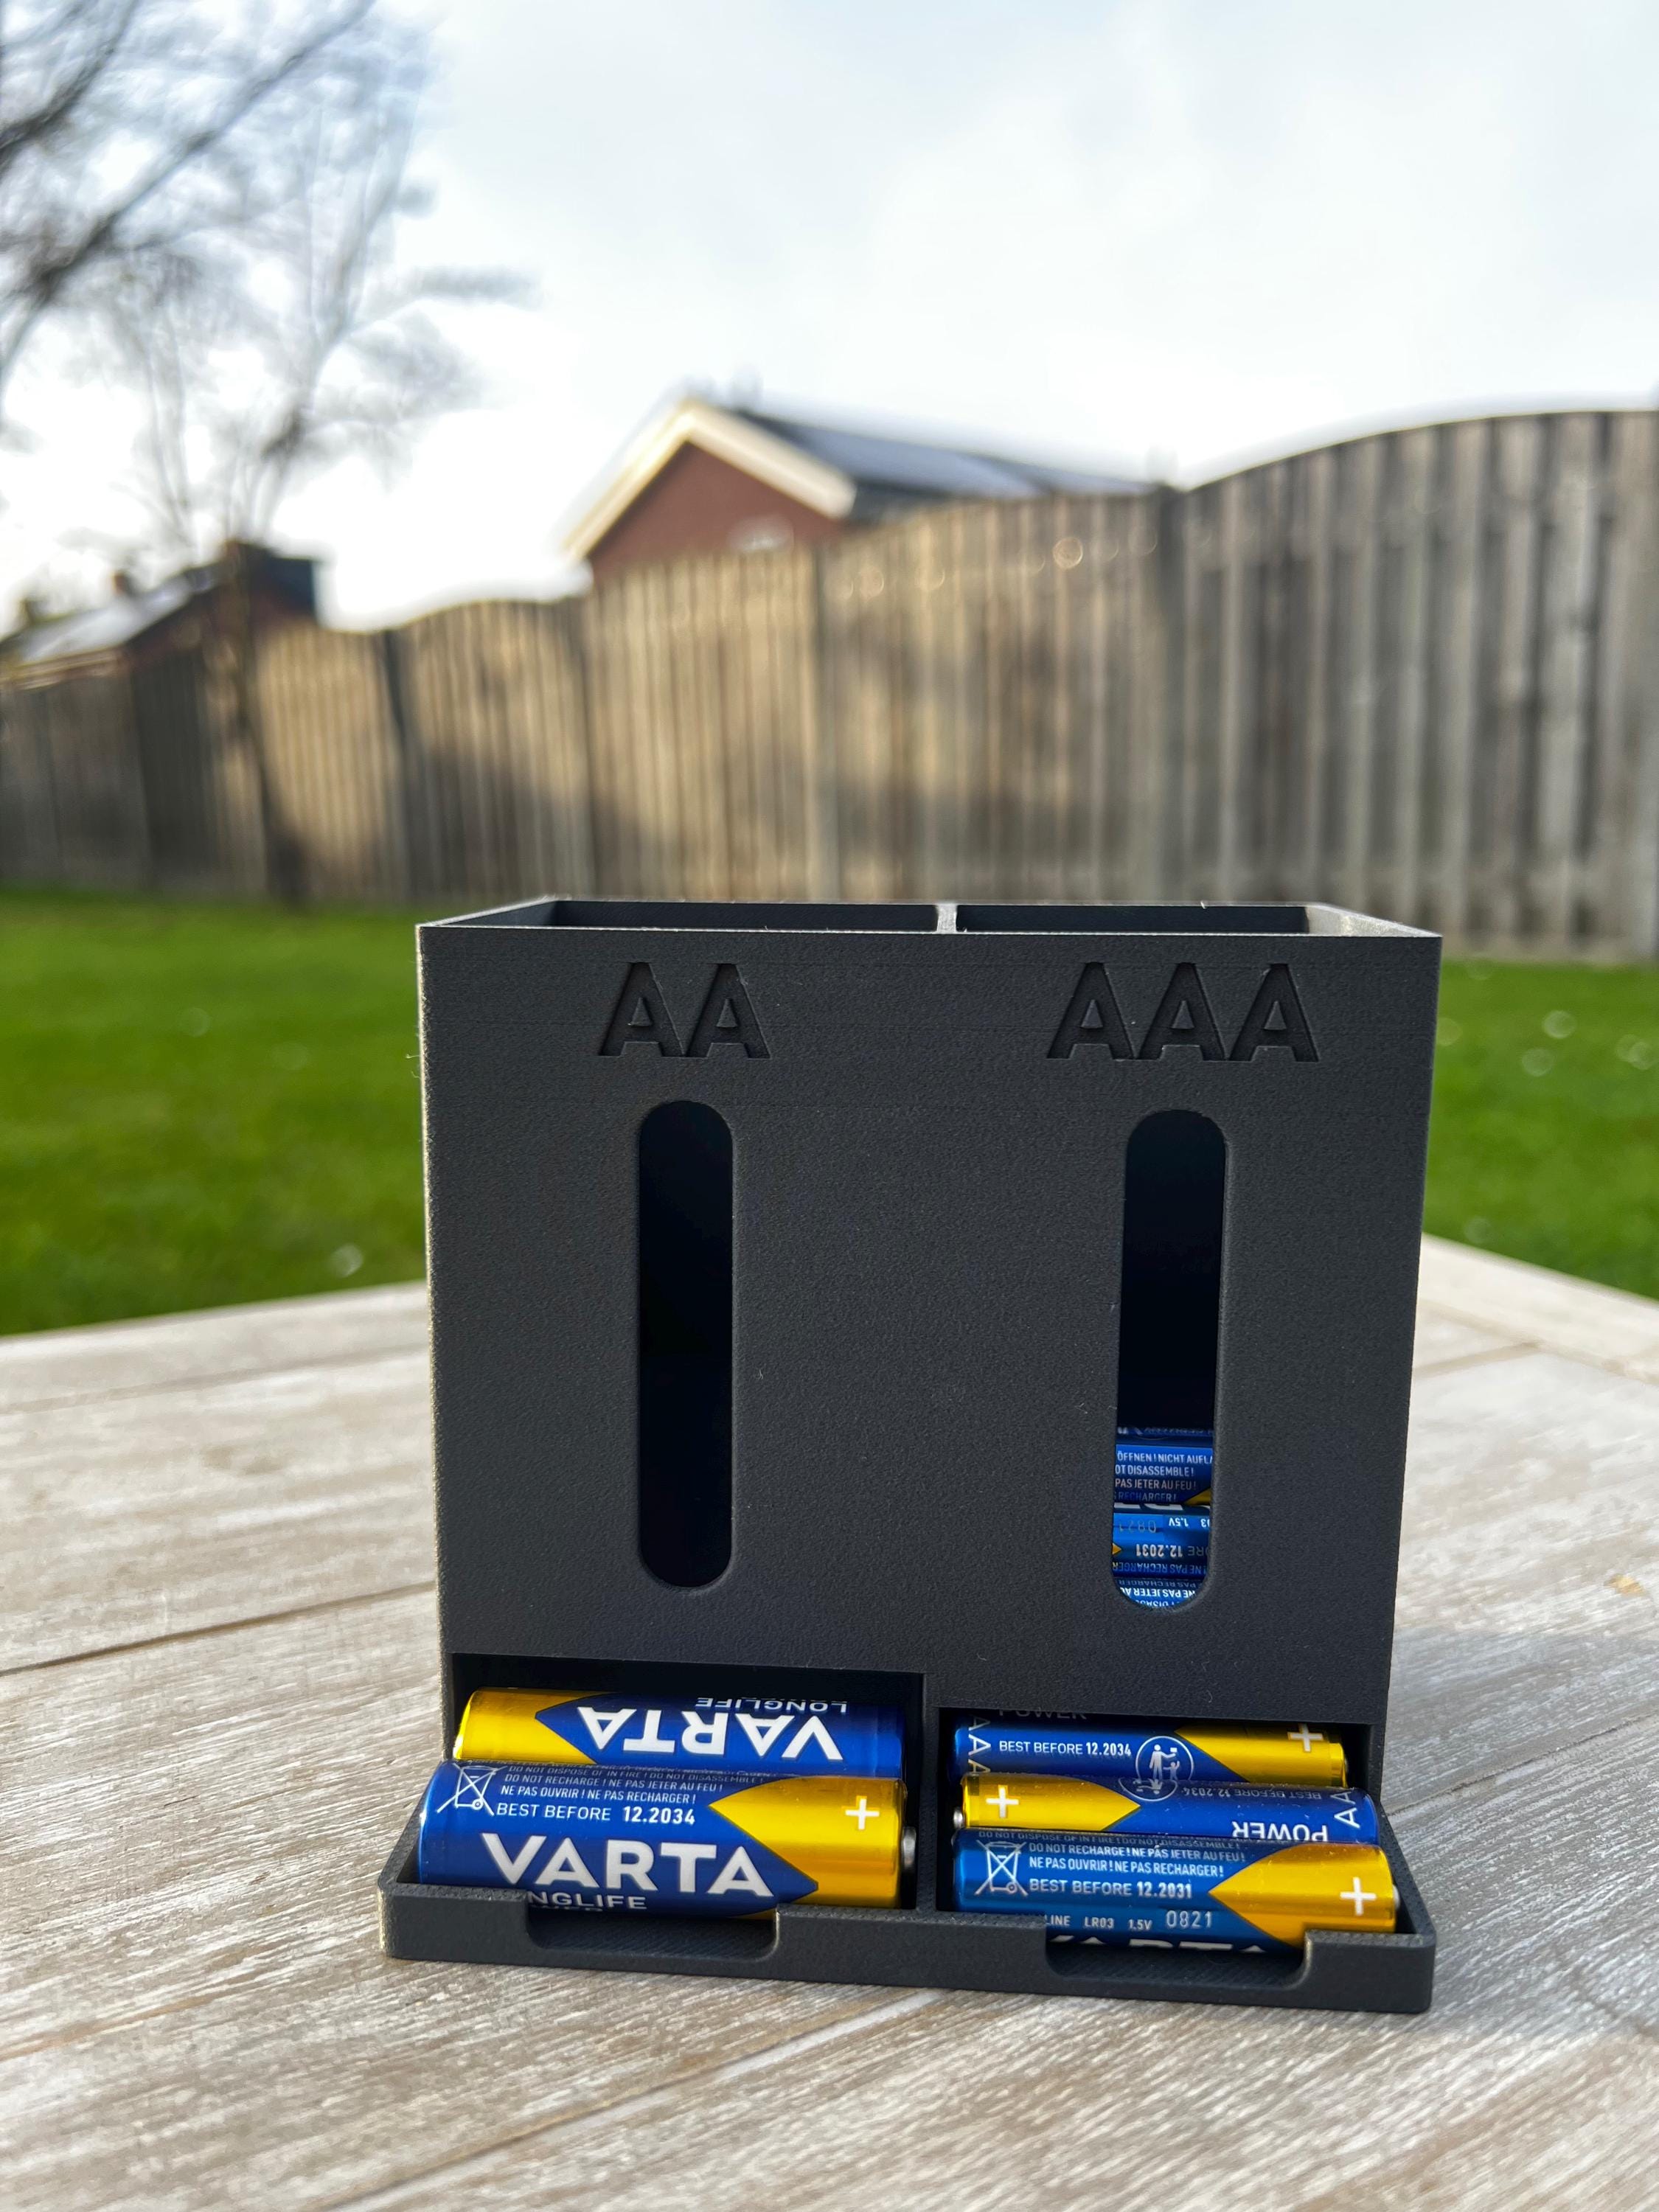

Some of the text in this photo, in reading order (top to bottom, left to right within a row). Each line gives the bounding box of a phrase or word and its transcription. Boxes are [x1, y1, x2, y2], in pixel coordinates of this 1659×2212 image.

[598, 961, 771, 1059] AA
[1046, 961, 1320, 1062] AAA
[1117, 1450, 1152, 1462] ÖFFNEN
[1158, 1453, 1184, 1463] NICHT
[1127, 1465, 1189, 1477] DISASSEMBLE
[1115, 1478, 1133, 1488] PAS
[1135, 1479, 1160, 1489] JETER
[1161, 1480, 1173, 1489] AU
[1175, 1481, 1192, 1490] FEU
[1118, 1492, 1172, 1502] RECHARGER
[1136, 1543, 1183, 1557] 12.2031
[1169, 1564, 1187, 1574] PAS
[1190, 1565, 1201, 1575] NE
[1133, 1587, 1160, 1596] JETER
[1163, 1589, 1182, 1598] PAS
[695, 1697, 848, 1714] LONGLIFE
[578, 1707, 844, 1761] VARTA
[999, 1740, 1132, 1756] BEST BEFORE 12.2034
[504, 1774, 519, 1782] DO
[522, 1775, 543, 1784] NOT
[546, 1775, 600, 1787] RECHARGE
[608, 1778, 622, 1787] NE
[626, 1779, 644, 1789] PAS
[647, 1780, 678, 1790] JETER
[680, 1781, 695, 1791] AU
[697, 1782, 717, 1792] FEU
[501, 1785, 515, 1795] NE
[518, 1787, 538, 1797] PAS
[540, 1787, 579, 1799] OUVRIR
[587, 1790, 601, 1800] NE
[604, 1791, 624, 1801] PAS
[627, 1791, 690, 1805] RECHARGER
[1234, 1789, 1285, 1798] BEFORE
[1290, 1790, 1322, 1800] BEST
[496, 1802, 696, 1826] BEST BEFORE 12.2034
[1231, 1820, 1328, 1842] POWER
[1029, 1843, 1043, 1852] DO
[1046, 1843, 1066, 1853] NOT
[1069, 1845, 1125, 1857] RECHARGE
[1132, 1848, 1146, 1857] NE
[1148, 1848, 1169, 1858] PAS
[1203, 1851, 1217, 1861] AU
[1219, 1851, 1239, 1862] FEU
[480, 1832, 774, 1897] VARTA
[1029, 1857, 1043, 1868] NE
[1046, 1857, 1066, 1870] PAS
[1068, 1859, 1107, 1871] OUVRIR
[1115, 1860, 1129, 1872] NE
[1130, 1862, 1151, 1874] PAS
[1153, 1863, 1217, 1877] RECHARGER
[1029, 1878, 1193, 1899] BEST BEFORE 12.2031
[1084, 1916, 1115, 1929] LR03
[1128, 1919, 1152, 1930] 1.5V
[1165, 1909, 1212, 1929] 0821
